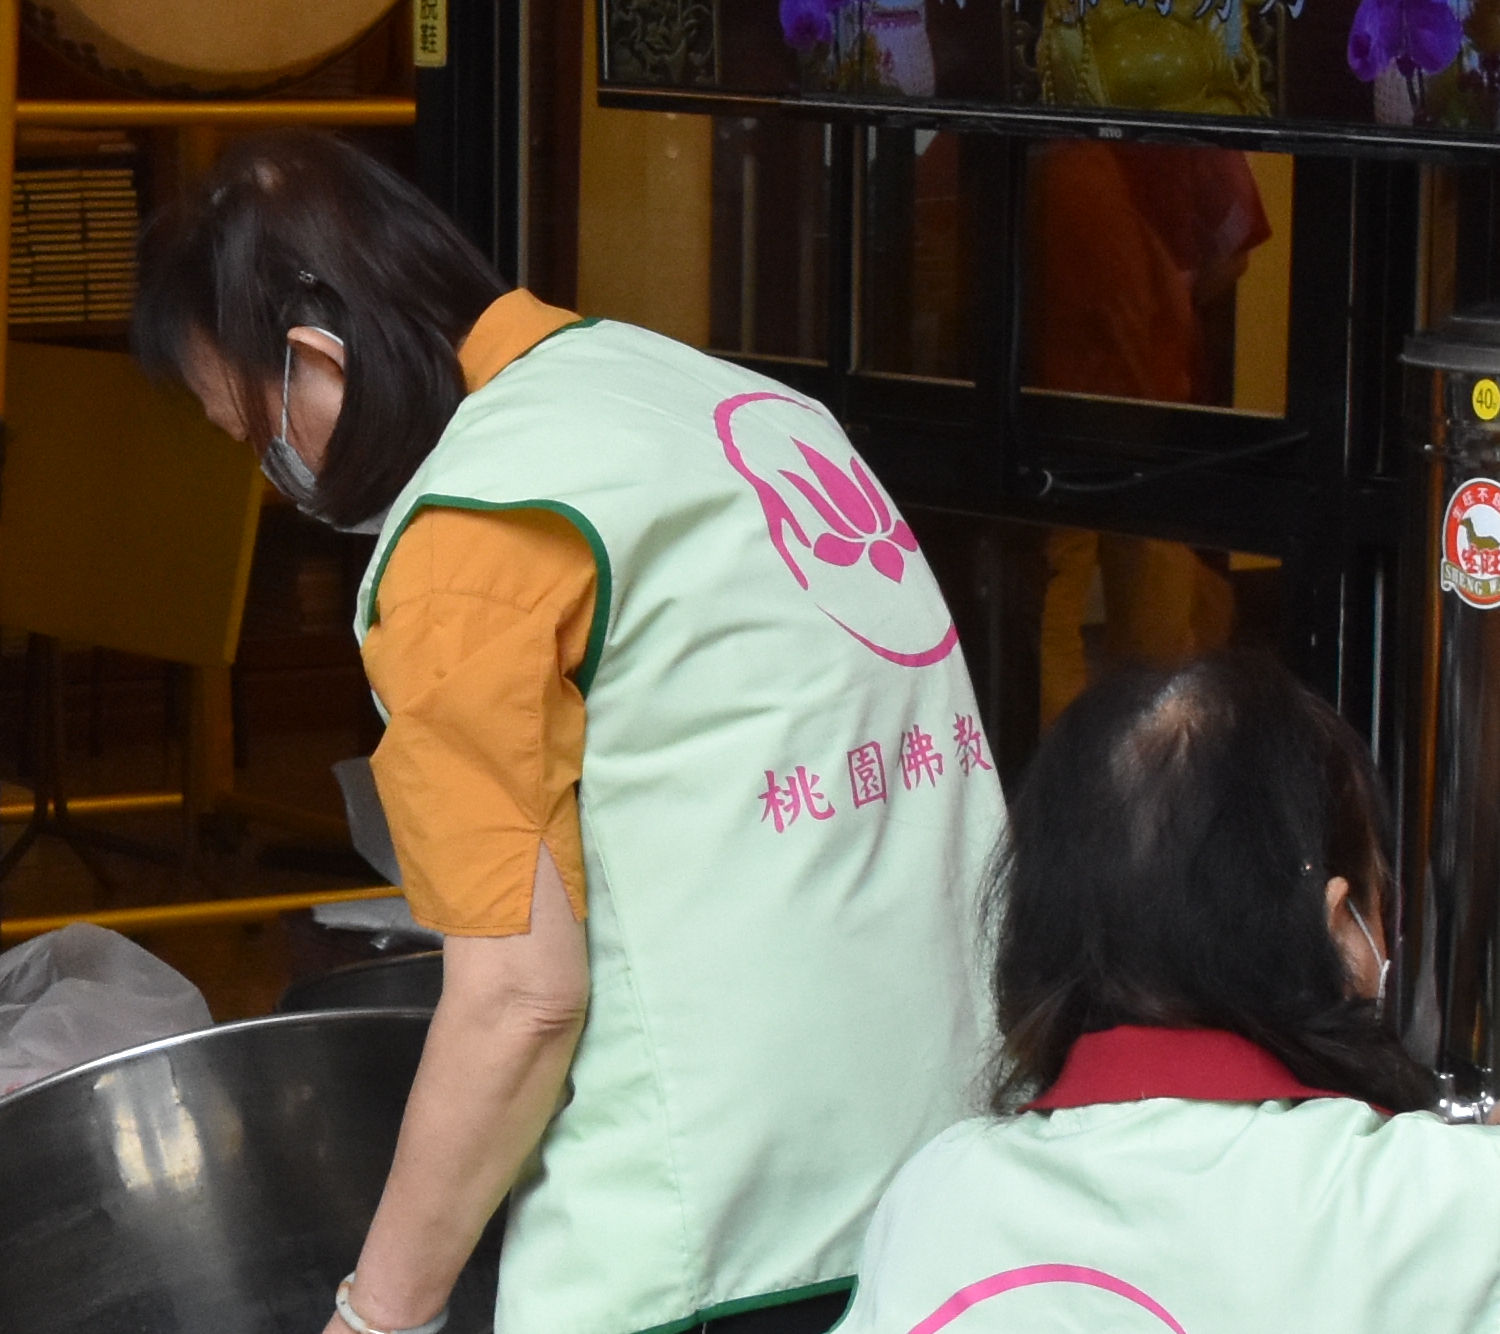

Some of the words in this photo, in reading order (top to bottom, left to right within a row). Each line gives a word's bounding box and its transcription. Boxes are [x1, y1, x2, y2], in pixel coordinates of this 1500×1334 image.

[1444, 565, 1483, 596] SHENG
[757, 712, 995, 834] 桃園佛教
